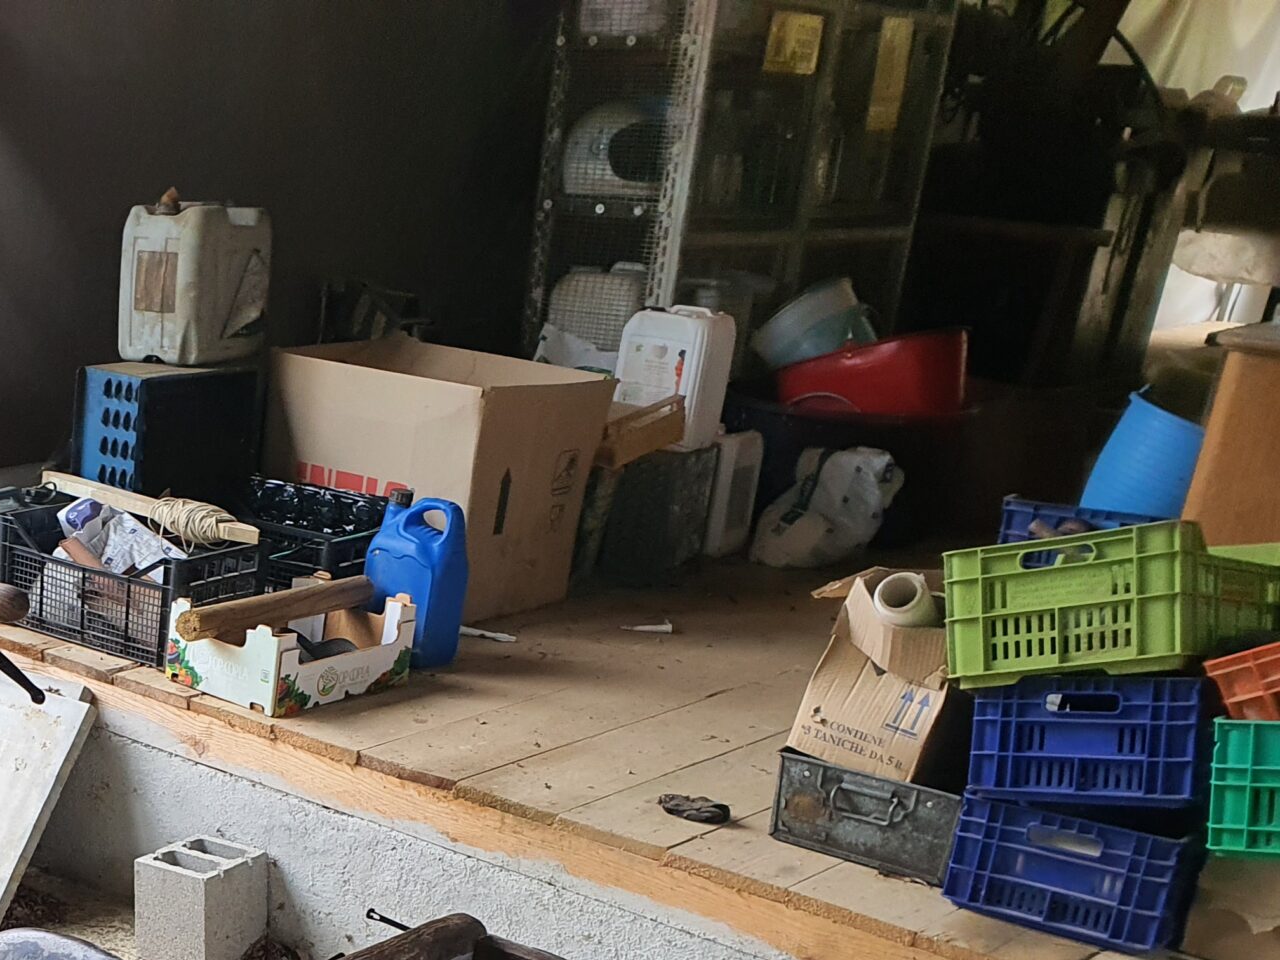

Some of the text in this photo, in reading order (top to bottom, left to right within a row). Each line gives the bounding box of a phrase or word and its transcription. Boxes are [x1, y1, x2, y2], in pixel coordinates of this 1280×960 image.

[814, 728, 867, 757] TANICHE
[869, 750, 884, 764] DA
[886, 755, 895, 766] 5
[830, 720, 885, 748] CONTIENE
